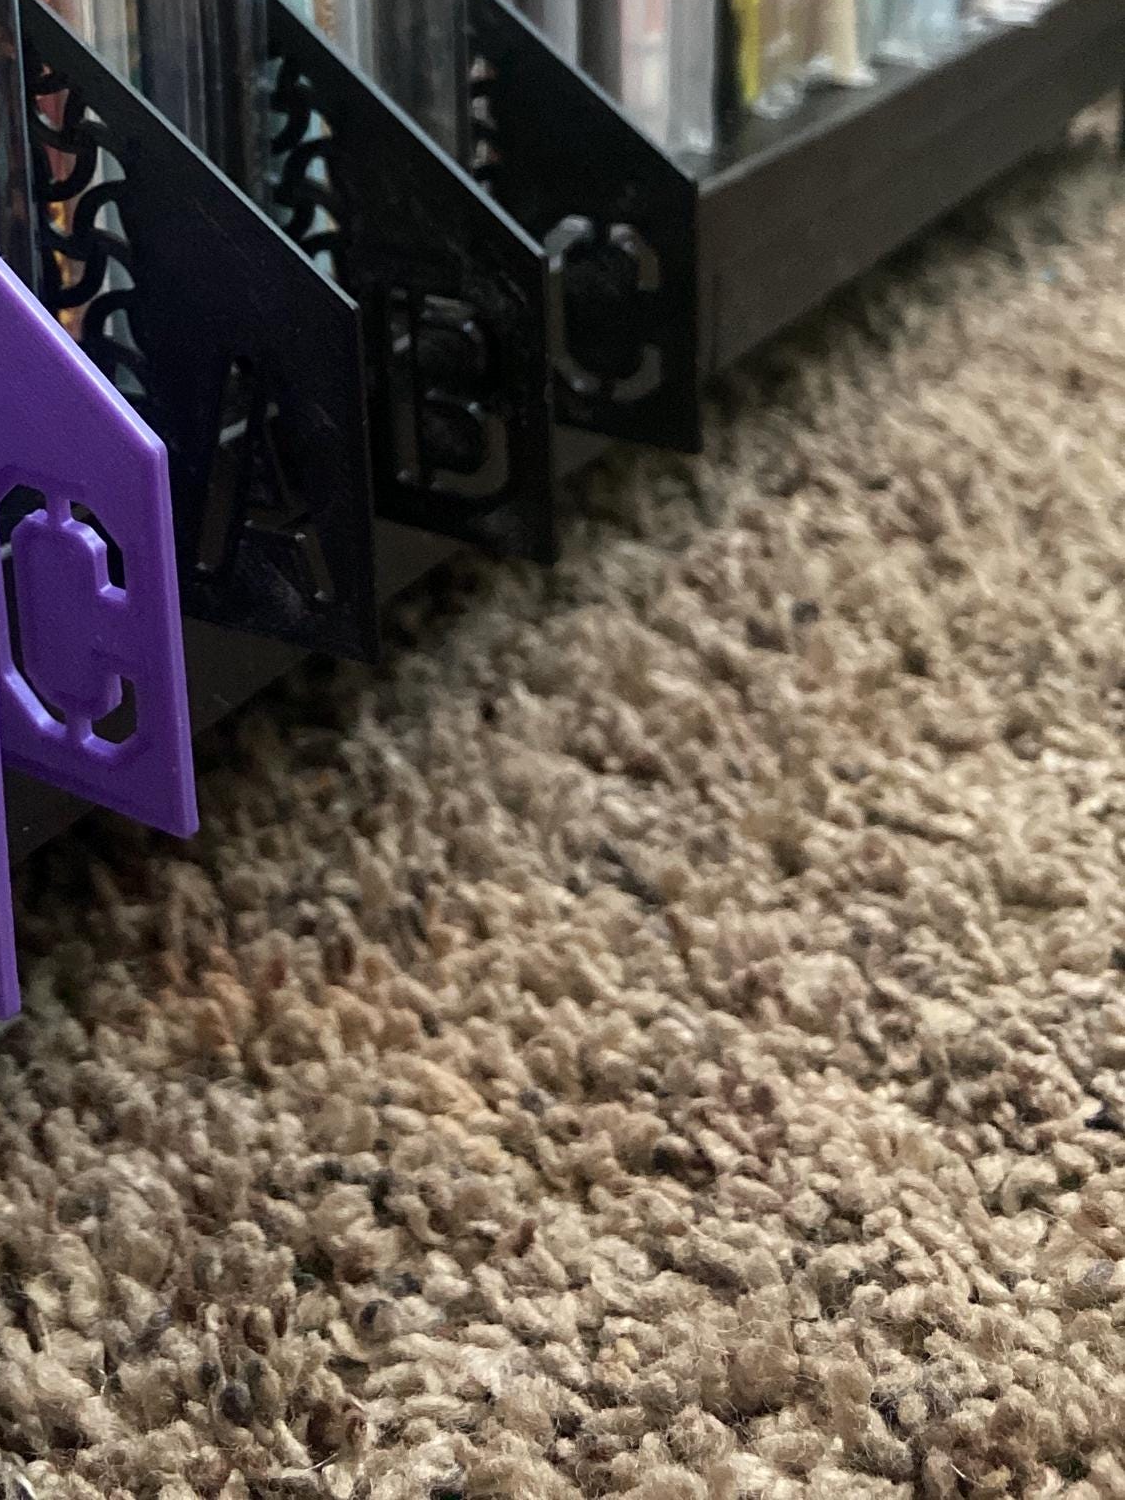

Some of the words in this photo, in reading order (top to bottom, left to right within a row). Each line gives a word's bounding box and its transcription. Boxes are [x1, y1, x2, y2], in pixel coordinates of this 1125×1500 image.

[384, 285, 510, 498] B
[542, 215, 663, 402] C
[194, 355, 335, 605] A
